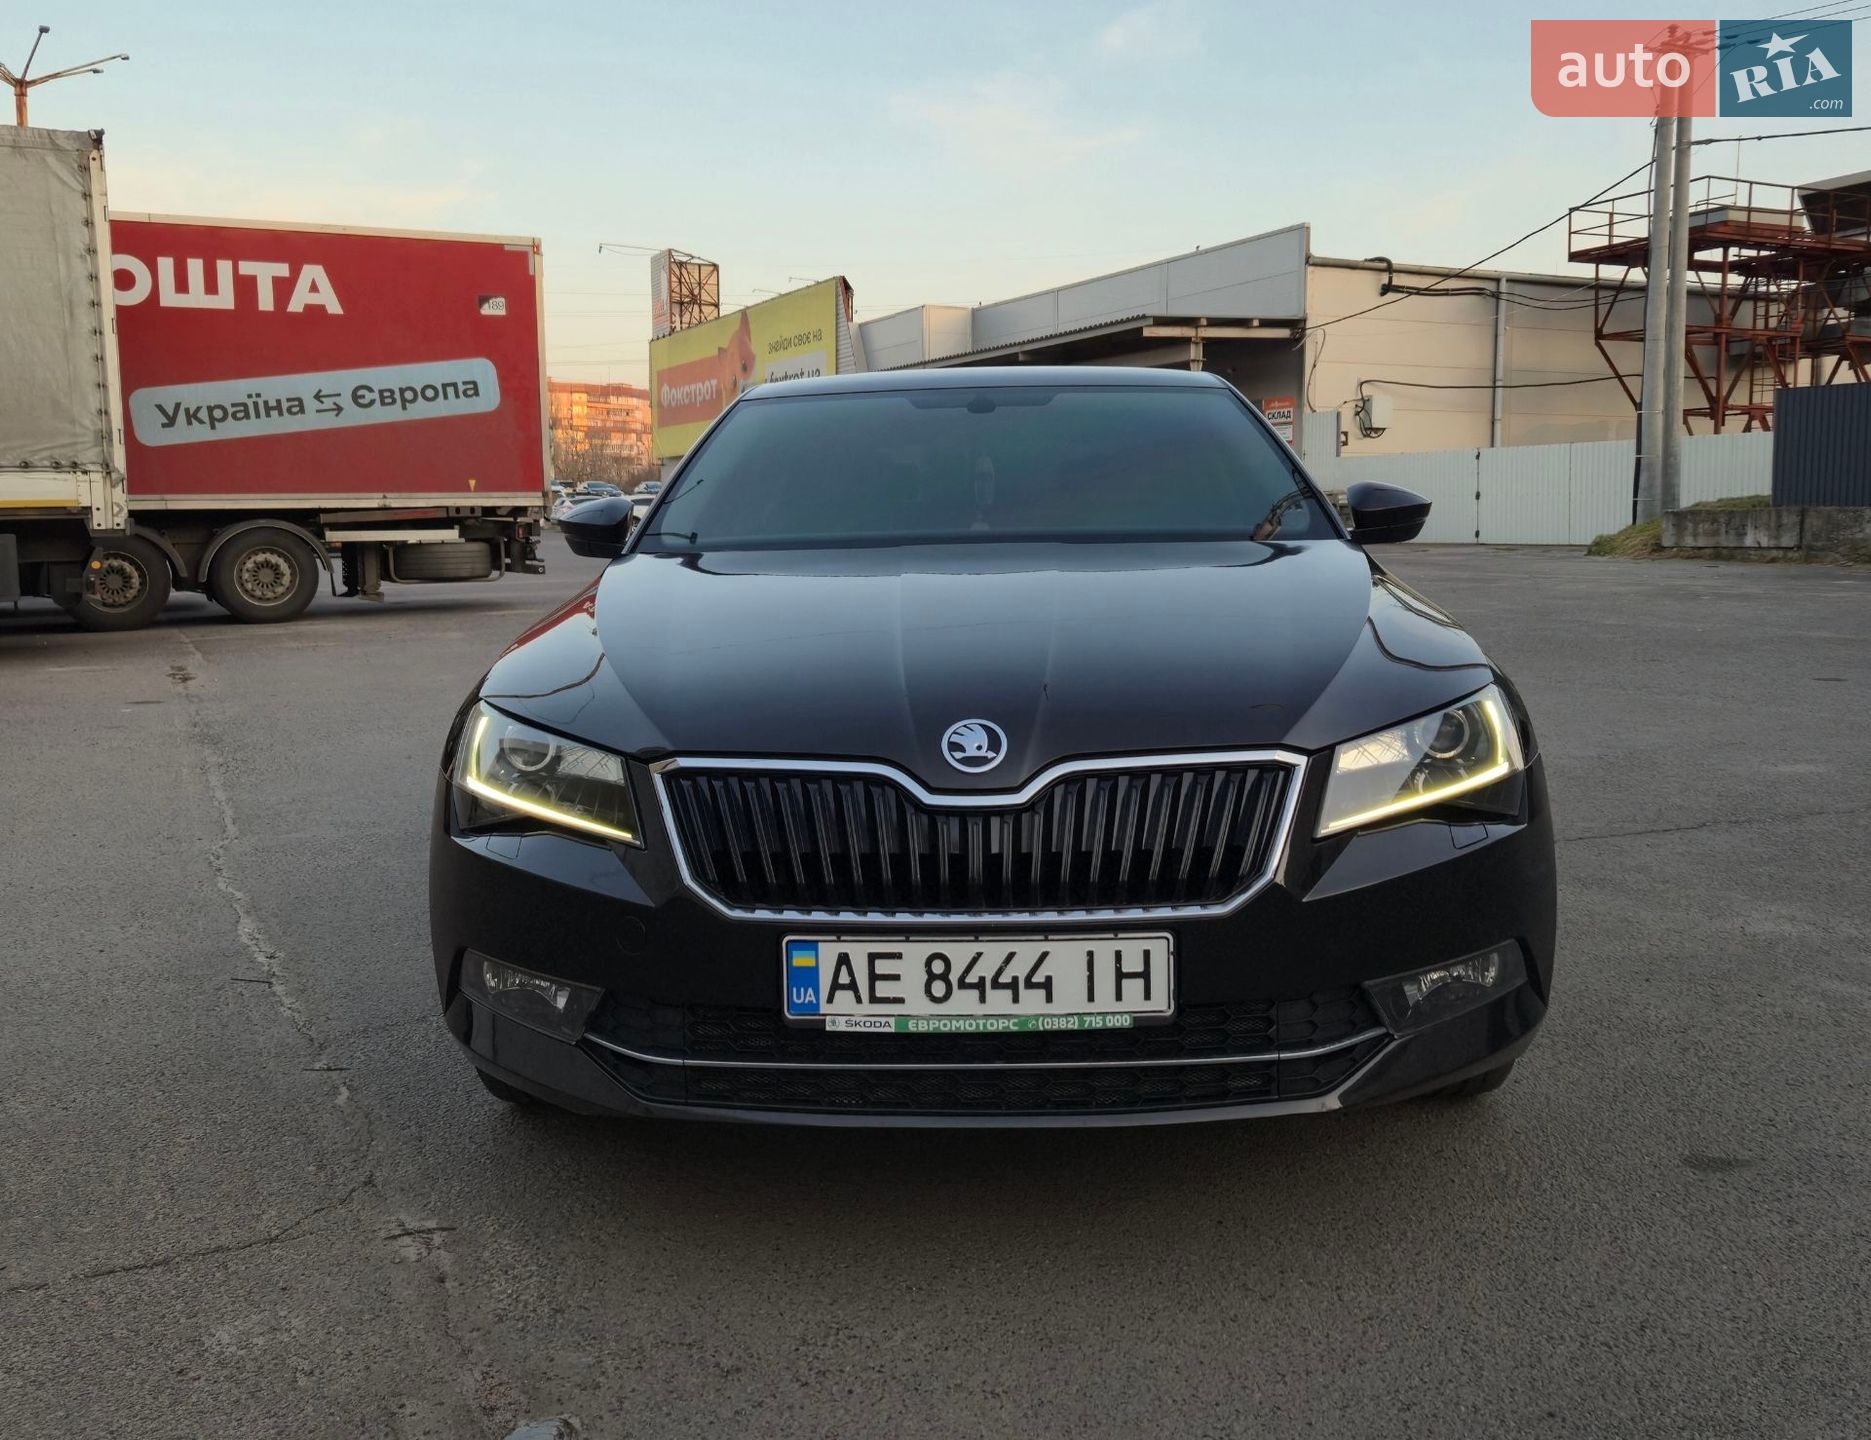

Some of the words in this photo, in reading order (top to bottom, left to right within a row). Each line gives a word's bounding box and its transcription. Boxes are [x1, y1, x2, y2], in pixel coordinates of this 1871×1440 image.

[112, 253, 344, 315] ОШТА
[812, 328, 823, 342] на
[154, 392, 306, 430] Україна
[351, 378, 481, 410] Європа
[661, 378, 718, 409] Фокстрот
[1267, 410, 1291, 420] СКЛАД
[826, 951, 905, 1005] AE
[923, 951, 1053, 1004] 8444
[1086, 949, 1152, 1002] IH
[792, 987, 816, 1004] UA
[908, 1019, 1019, 1031] ЄВРОМОТОРС
[1038, 1016, 1079, 1030] (0382)
[1083, 1015, 1104, 1028] 715
[1106, 1015, 1130, 1027] 000
